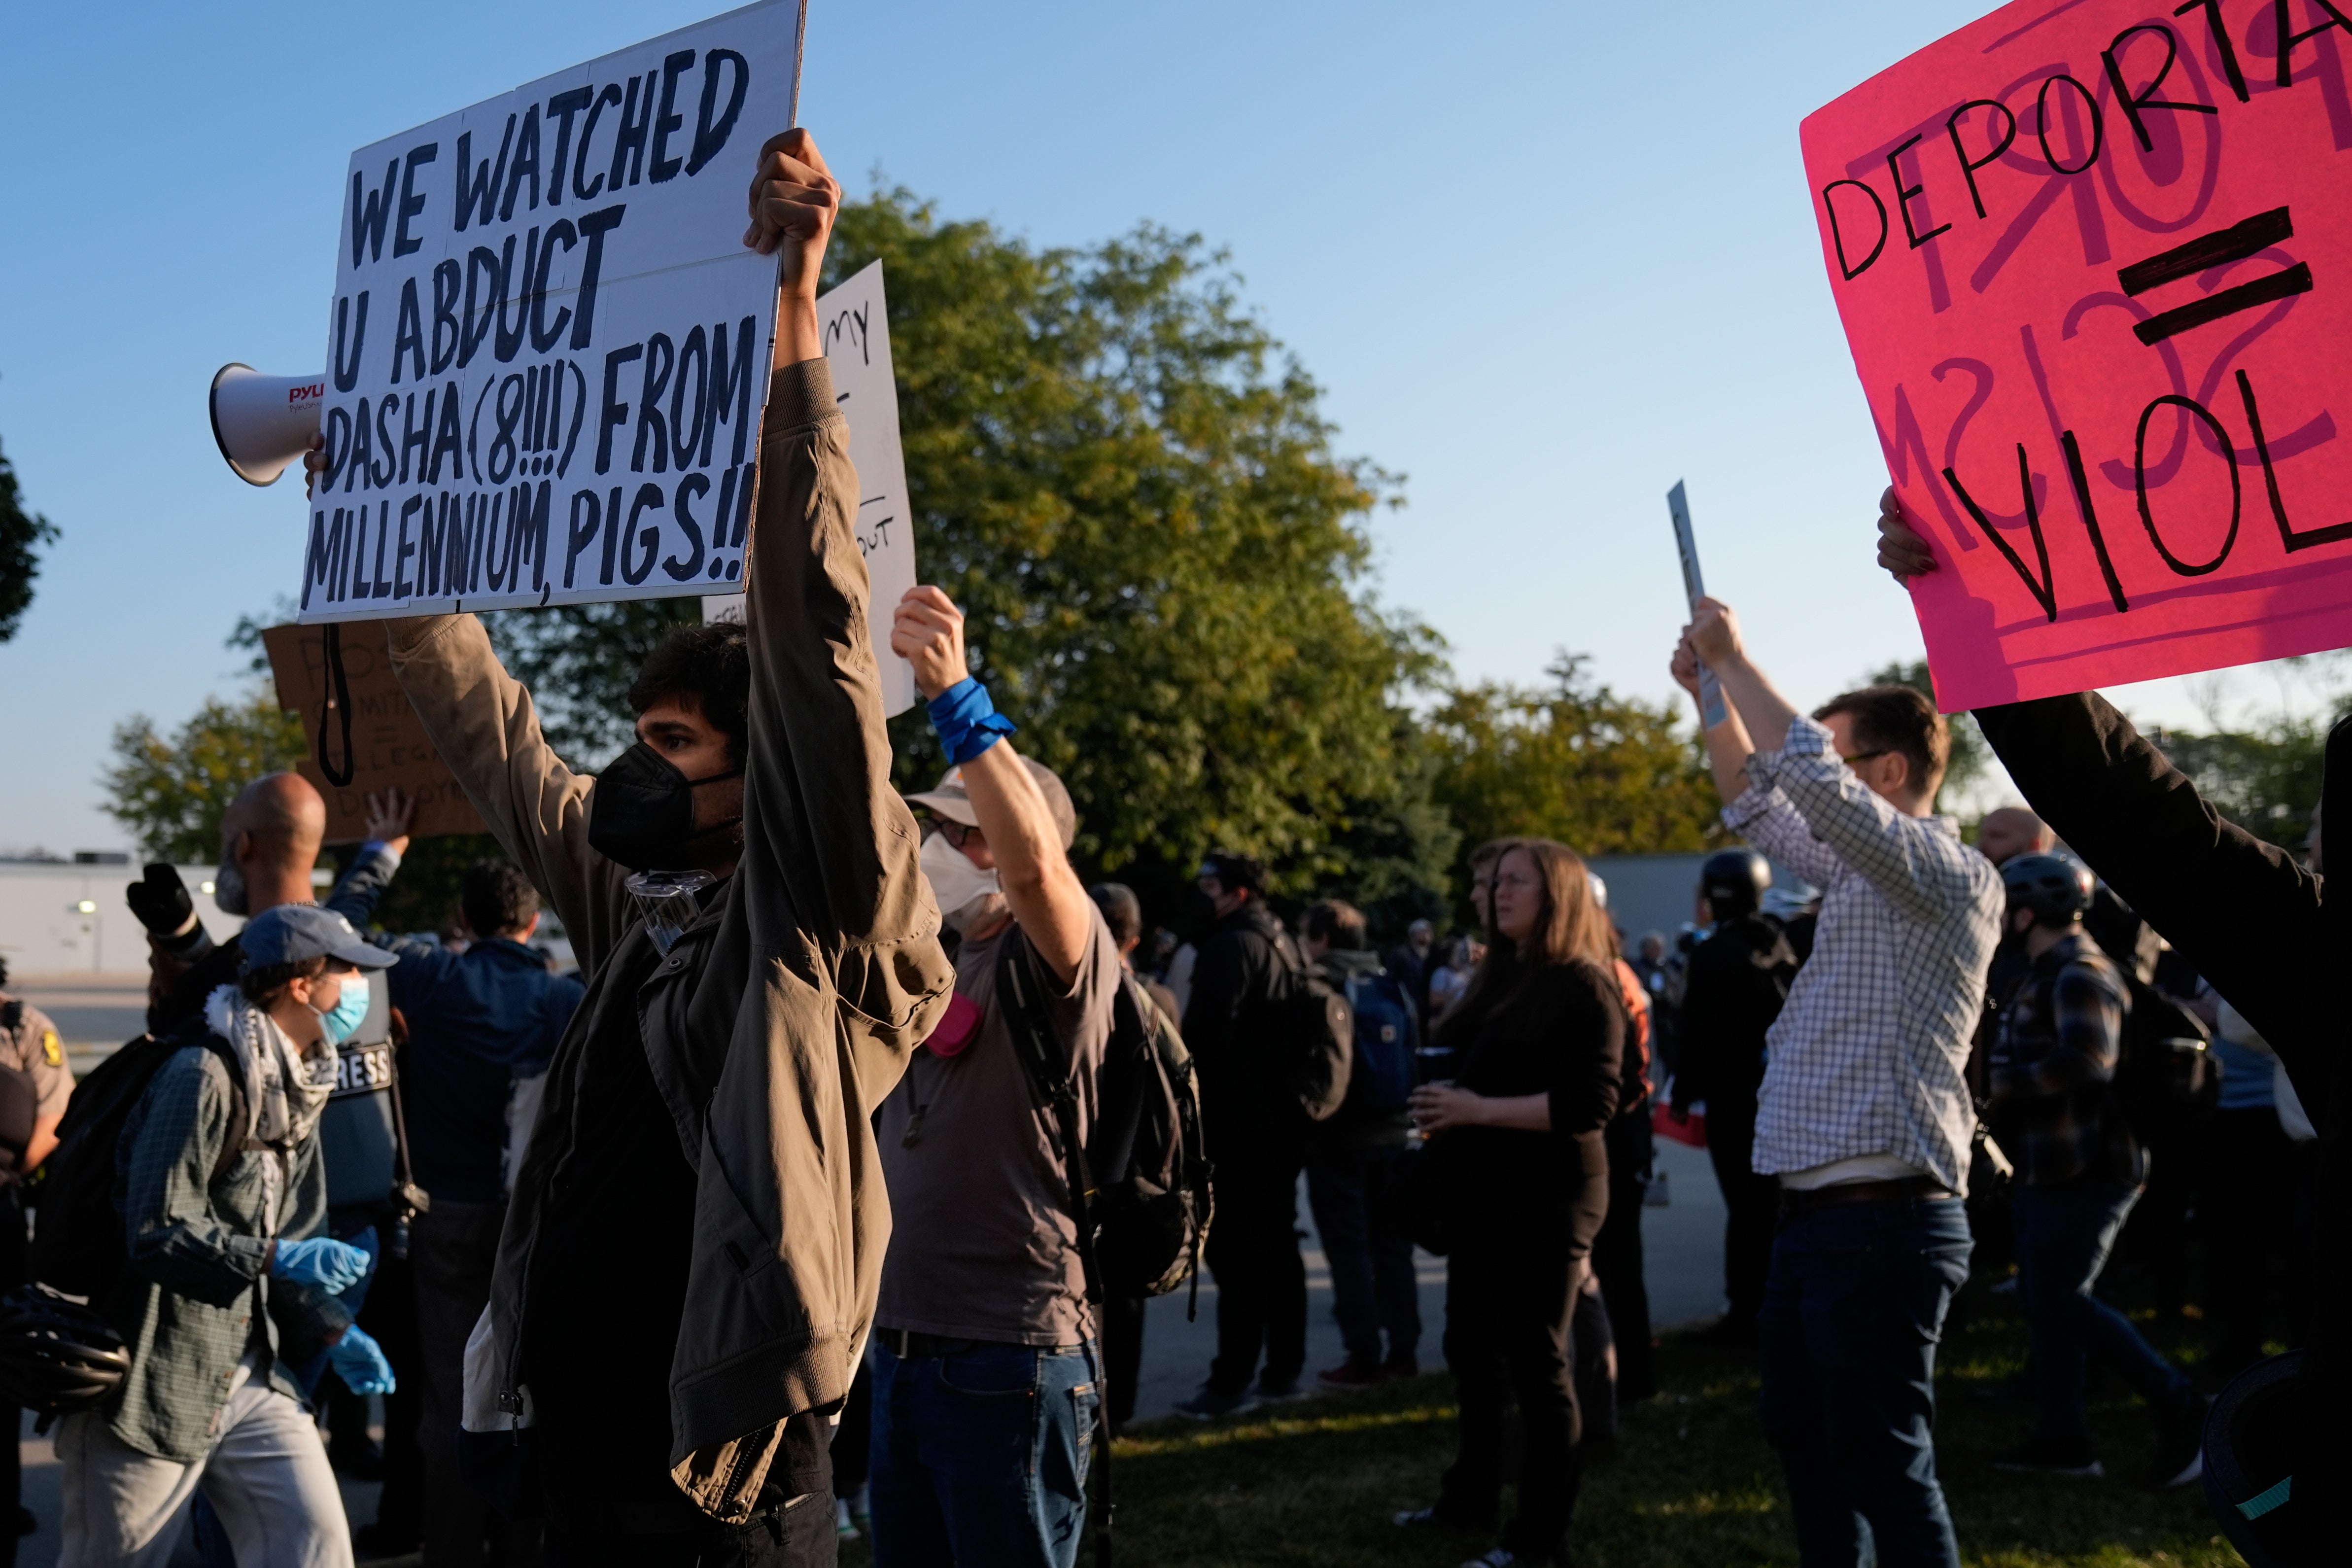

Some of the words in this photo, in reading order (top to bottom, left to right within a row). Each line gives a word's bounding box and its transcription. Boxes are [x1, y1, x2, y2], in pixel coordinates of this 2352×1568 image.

[352, 141, 438, 270] WE
[454, 48, 749, 234] WATCHED
[334, 290, 369, 393] U
[391, 203, 627, 384] ABDUCT
[596, 315, 756, 474] FROM
[303, 478, 551, 611] MILLENNIUM,
[564, 461, 755, 588] PIGS!!
